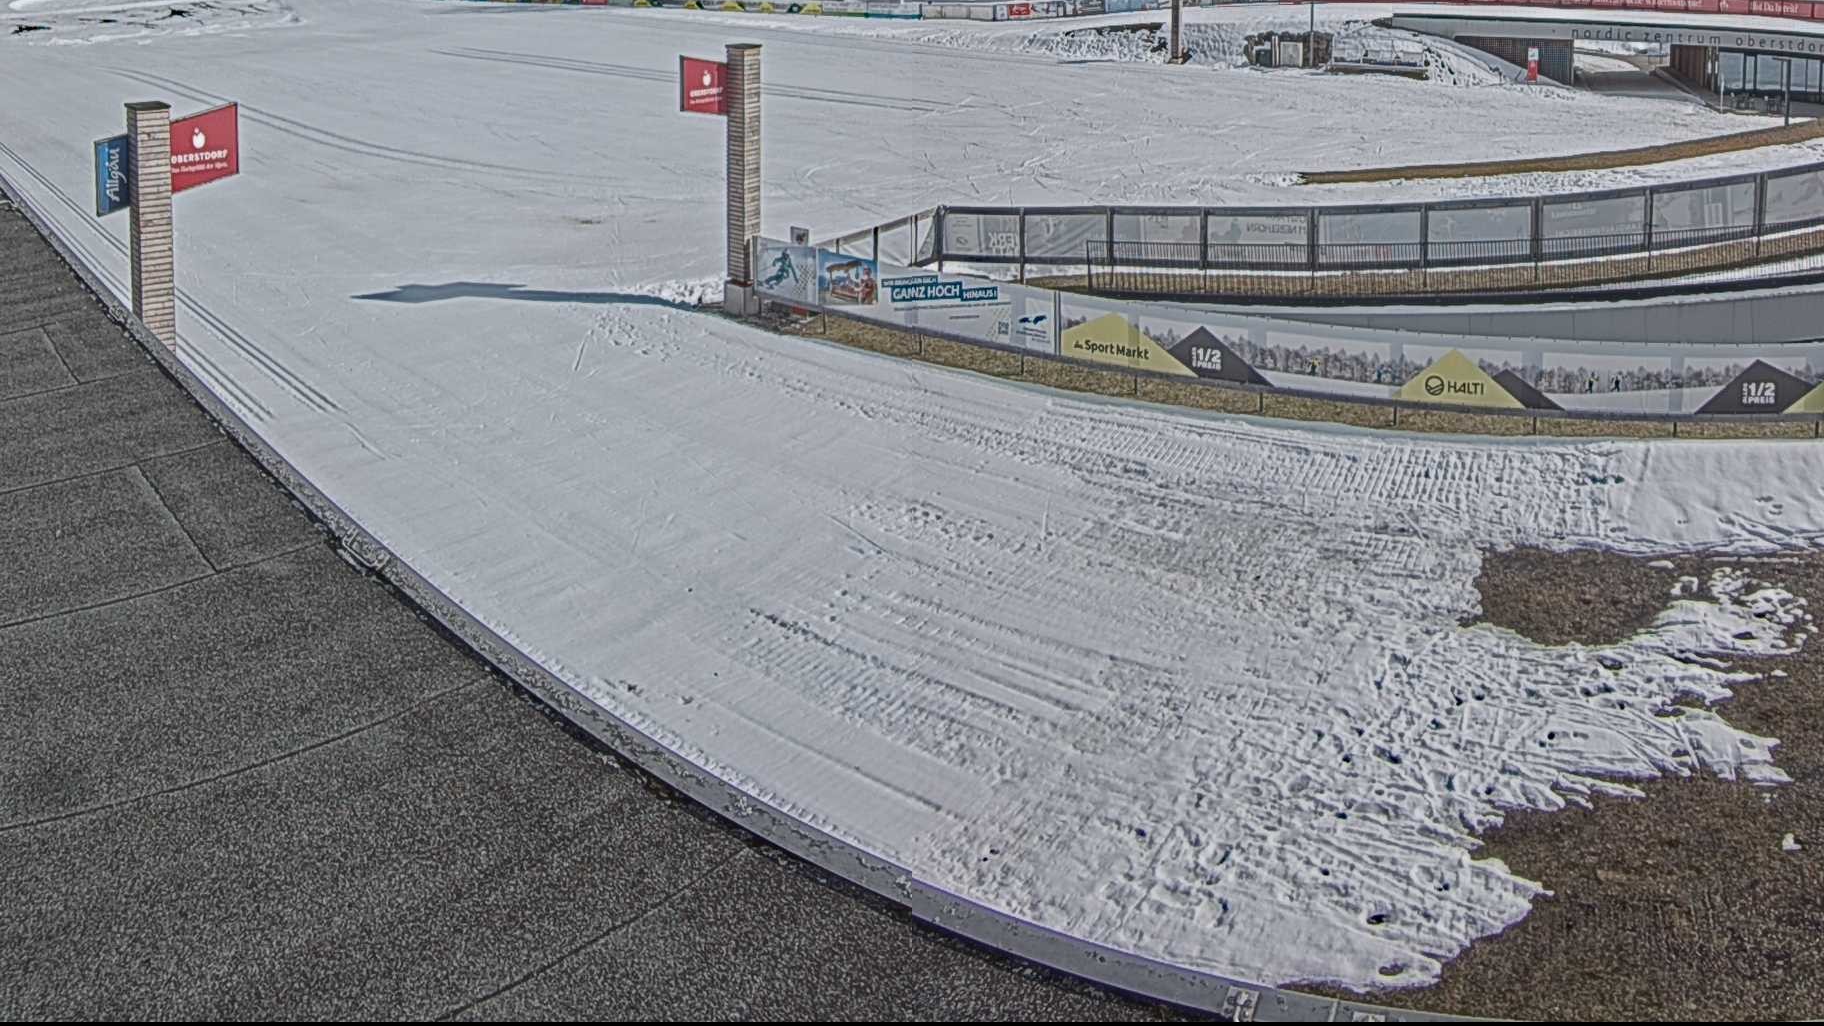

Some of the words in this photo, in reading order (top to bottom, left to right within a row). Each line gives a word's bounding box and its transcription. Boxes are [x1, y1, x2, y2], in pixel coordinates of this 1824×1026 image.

[1571, 27, 1632, 40] nordic
[1644, 32, 1721, 45] zentrum
[927, 284, 961, 298] HOCH
[1197, 347, 1222, 363] 1/2
[1447, 380, 1484, 395] HALTI
[1748, 382, 1776, 396] 1/2
